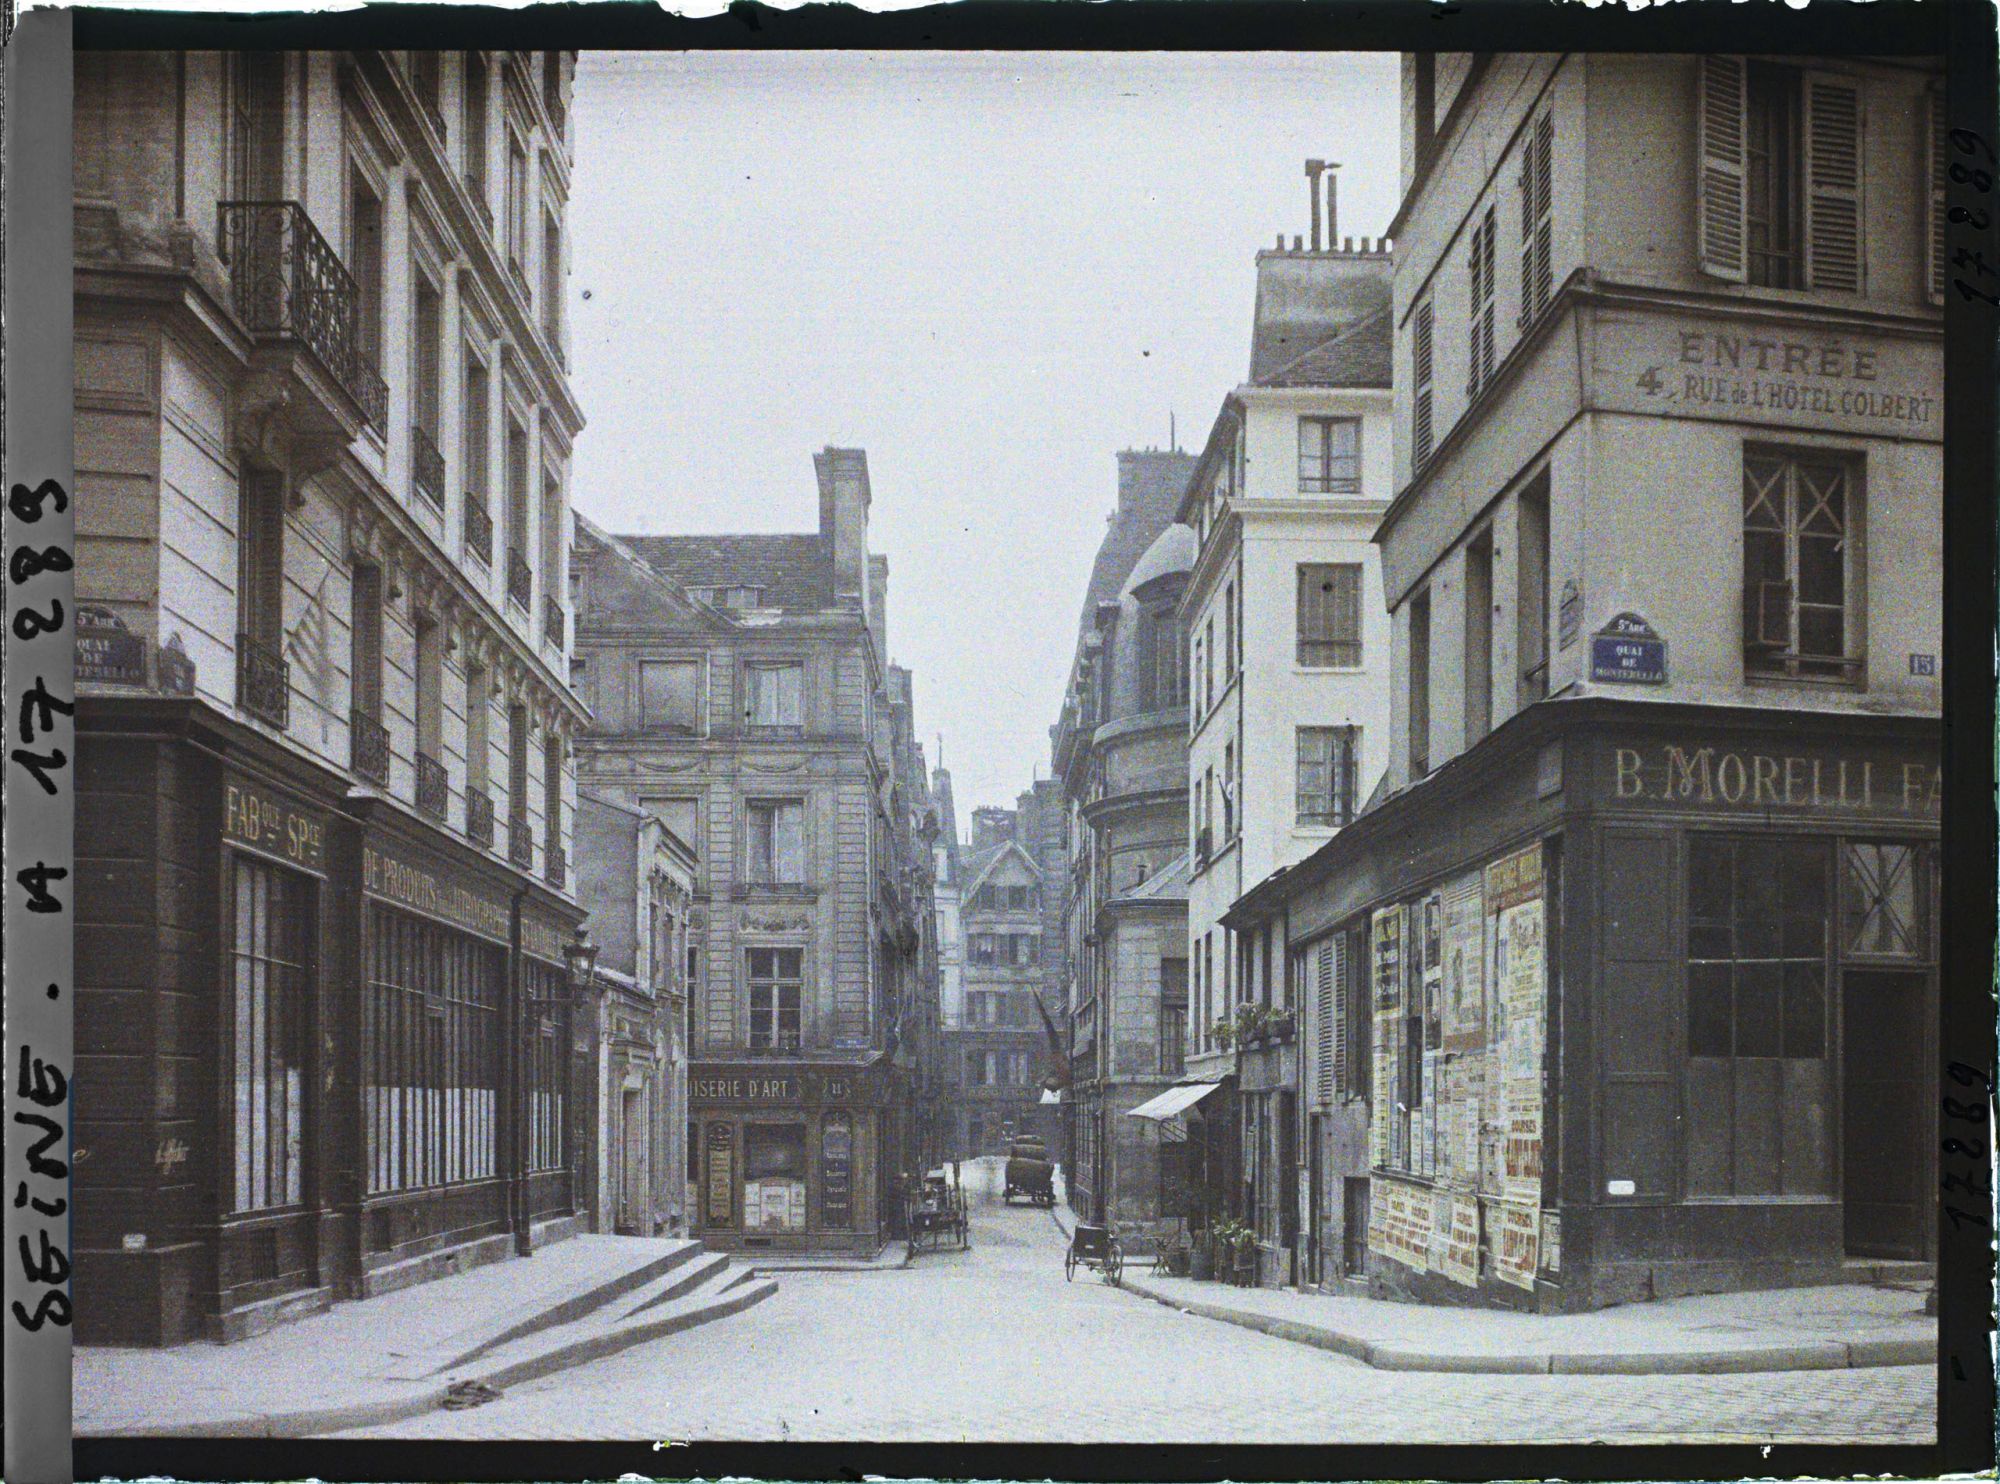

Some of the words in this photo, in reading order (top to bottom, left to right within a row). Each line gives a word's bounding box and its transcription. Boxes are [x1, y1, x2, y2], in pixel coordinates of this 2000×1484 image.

[1678, 329, 1878, 382] ENTRÉE
[1683, 373, 1729, 402] RUE
[1839, 389, 1935, 423] COLBERT
[1616, 645, 1643, 656] QUAI
[1622, 657, 1638, 668] DE
[1663, 745, 1875, 808] MORELLI
[363, 846, 379, 890] DE
[749, 1079, 788, 1097] D'ART
